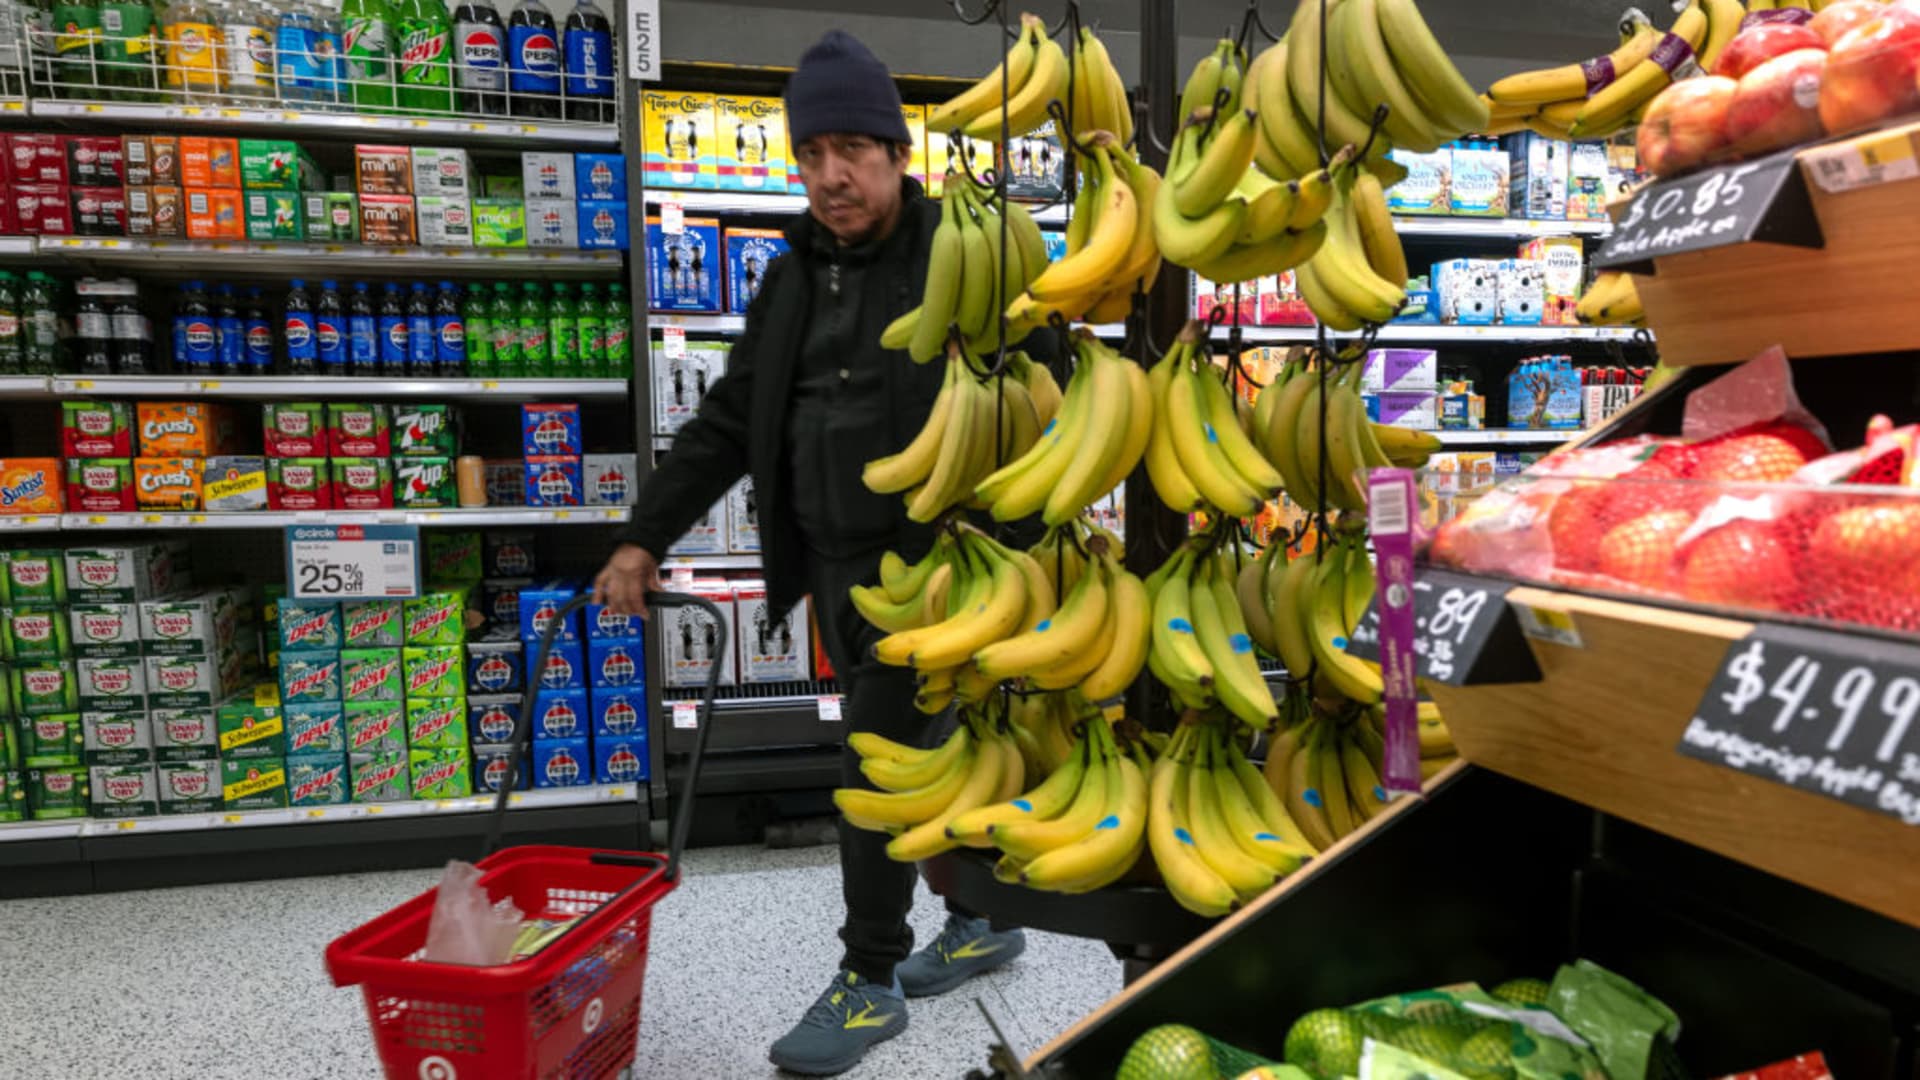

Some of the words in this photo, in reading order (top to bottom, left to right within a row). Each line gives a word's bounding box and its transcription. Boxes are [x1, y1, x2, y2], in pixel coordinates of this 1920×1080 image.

[584, 38, 598, 88] PEPSI
[362, 159, 396, 171] mini
[1620, 164, 1760, 229] $0.85
[364, 208, 398, 220] mini
[144, 417, 196, 440] Crush
[140, 470, 192, 492] Crush
[211, 476, 260, 498] Schweppes
[542, 484, 570, 492] PEPSI
[12, 566, 48, 574] CANADA
[300, 564, 343, 593] 25
[344, 563, 364, 580] %
[344, 580, 364, 591] off
[82, 620, 122, 628] CANADA
[153, 618, 192, 626] CANADA
[288, 616, 326, 642] DEW
[351, 611, 388, 638] DEW
[412, 609, 448, 636] DEW
[25, 676, 64, 684] CANADA
[92, 673, 131, 682] CANADA
[159, 672, 198, 680] CANADA
[288, 671, 328, 698] DEW
[351, 668, 386, 696] DEW
[412, 661, 448, 689] DEW
[1722, 640, 1920, 762] $4.99
[96, 728, 136, 736] CANADA
[166, 724, 204, 732] CANADA
[227, 723, 274, 744] Schweppes
[294, 723, 331, 750] DEW
[356, 720, 390, 747] DEW
[416, 712, 452, 740] DEW
[104, 780, 144, 788] CANADA
[171, 776, 208, 784] CANADA
[232, 775, 279, 795] Schweppes
[357, 767, 394, 792] DEW
[417, 765, 456, 791] DEW
[1811, 756, 1883, 796] Apple
[114, 788, 134, 796] DRY
[294, 775, 333, 800] DEW
